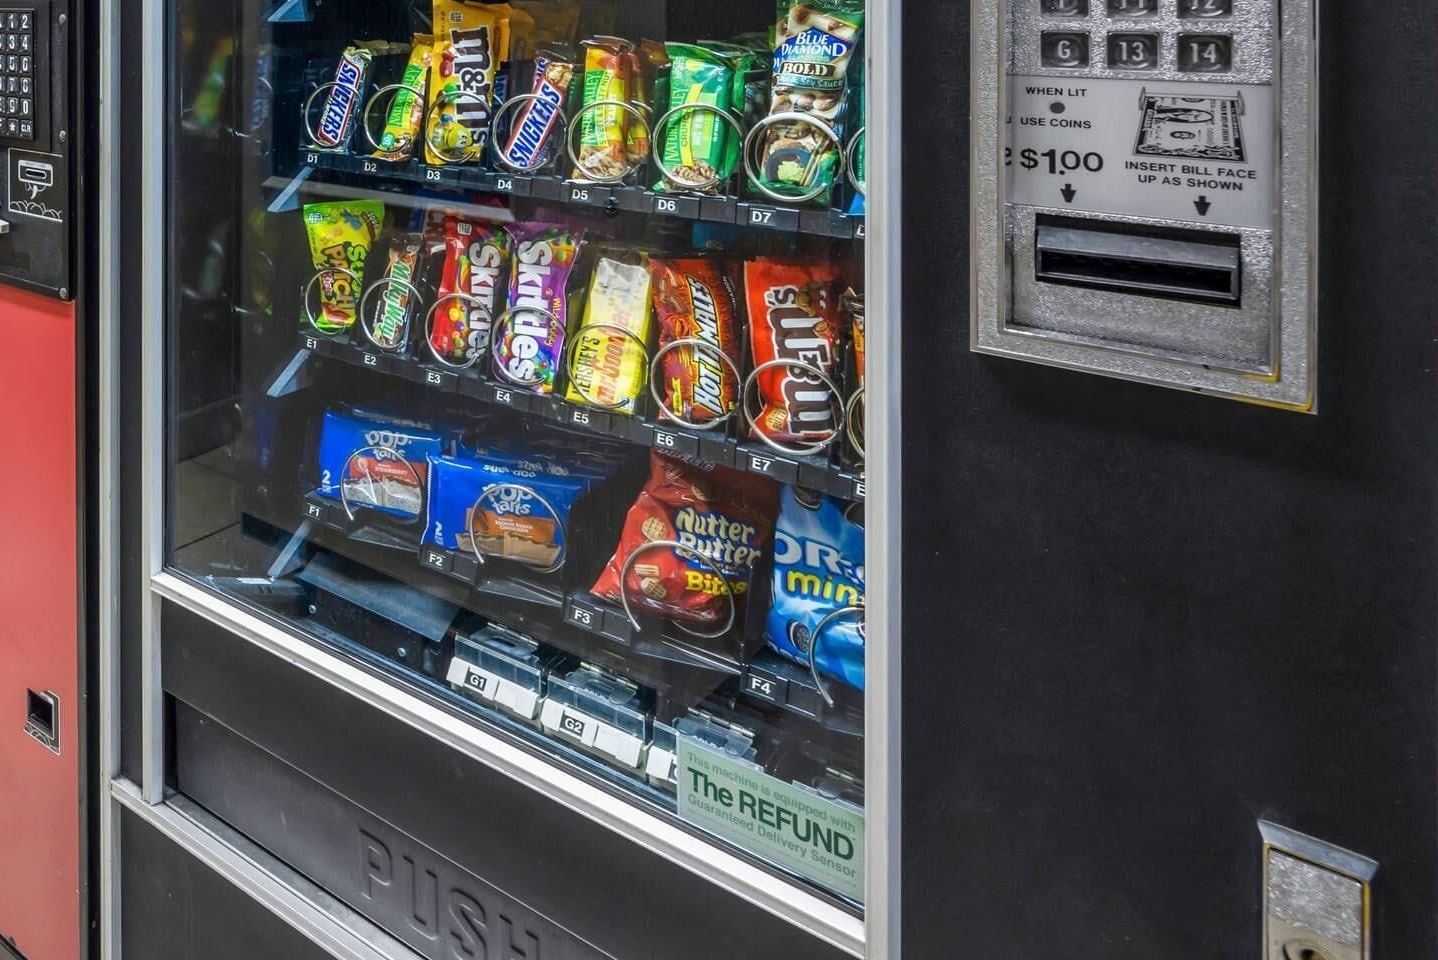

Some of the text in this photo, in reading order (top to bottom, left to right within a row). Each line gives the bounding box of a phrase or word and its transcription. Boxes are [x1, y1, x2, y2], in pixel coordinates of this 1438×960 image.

[795, 30, 829, 45] BLUE
[781, 42, 848, 57] DIAMOND
[1057, 39, 1071, 60] G
[1119, 41, 1144, 62] 13
[1190, 42, 1217, 64] 14
[781, 62, 828, 76] BOLD
[816, 78, 843, 88] Sauce
[1024, 86, 1088, 97] WHEN LIT
[22, 99, 29, 114] 0
[322, 62, 358, 141] SNICKERS
[21, 124, 31, 133] CLR
[508, 81, 561, 168] SNICKERS
[1019, 116, 1092, 129] USE COINS
[307, 154, 318, 164] D1
[1019, 147, 1104, 176] $1.00
[364, 162, 377, 172] D2
[1124, 160, 1258, 180] INSERT BILL FACE
[426, 169, 441, 180] D3
[497, 179, 512, 190] D4
[1137, 173, 1244, 191] UP AS SHOWN
[571, 188, 588, 200] D5
[657, 198, 676, 211] D6
[751, 210, 772, 223] D7
[508, 240, 553, 380] Skittles
[306, 338, 317, 349] E1
[686, 276, 726, 416] HOT TAMALES
[364, 355, 377, 365] E2
[427, 372, 441, 383] E3
[496, 391, 510, 402] E4
[573, 411, 589, 424] E5
[656, 433, 674, 447] E6
[751, 457, 771, 471] E7
[321, 468, 331, 485] 2
[308, 505, 320, 517] F1
[492, 499, 531, 515] tarts
[675, 507, 756, 545] Nutter
[675, 530, 762, 567] Butter
[429, 553, 443, 566] F2
[684, 569, 749, 597] Bites
[574, 611, 590, 624] F3
[469, 674, 485, 689] G1
[751, 680, 771, 694] F4
[563, 718, 583, 734] G2
[688, 751, 710, 770] This
[712, 762, 759, 792] machine
[761, 786, 771, 797] is
[773, 790, 828, 821] equipped
[830, 817, 856, 834] with
[687, 766, 734, 808] The
[738, 789, 855, 861] REFUND
[687, 793, 754, 832] Guaranteed
[757, 825, 807, 858] Delivery
[809, 848, 857, 878] Sensor
